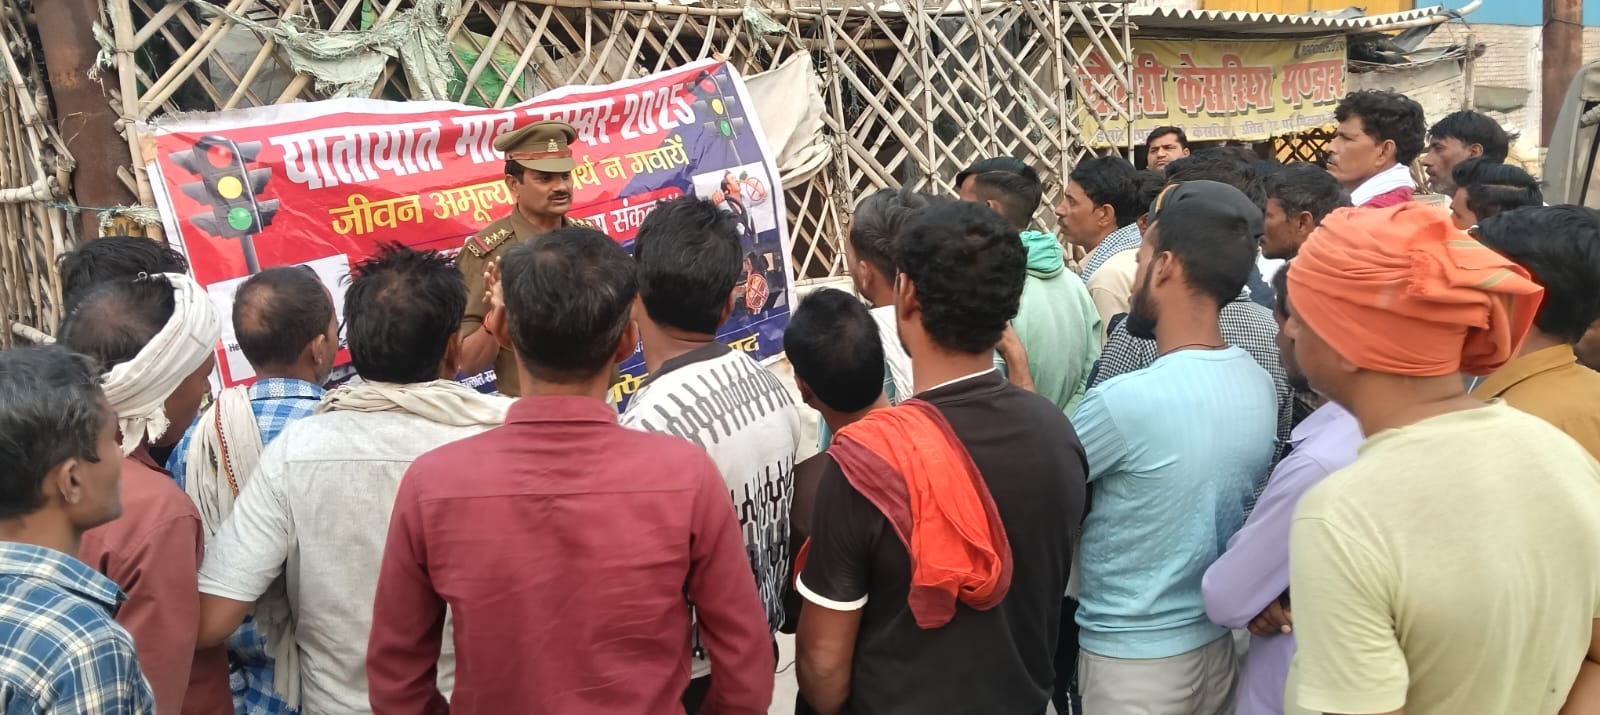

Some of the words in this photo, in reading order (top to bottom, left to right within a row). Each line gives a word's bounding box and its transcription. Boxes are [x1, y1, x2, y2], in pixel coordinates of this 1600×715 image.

[269, 119, 444, 190] यातायात
[526, 82, 696, 147] म्बर-2025
[328, 192, 424, 236] जीवन
[430, 180, 515, 223] अमूल्य
[599, 156, 628, 180] न
[625, 133, 691, 175] गवायें
